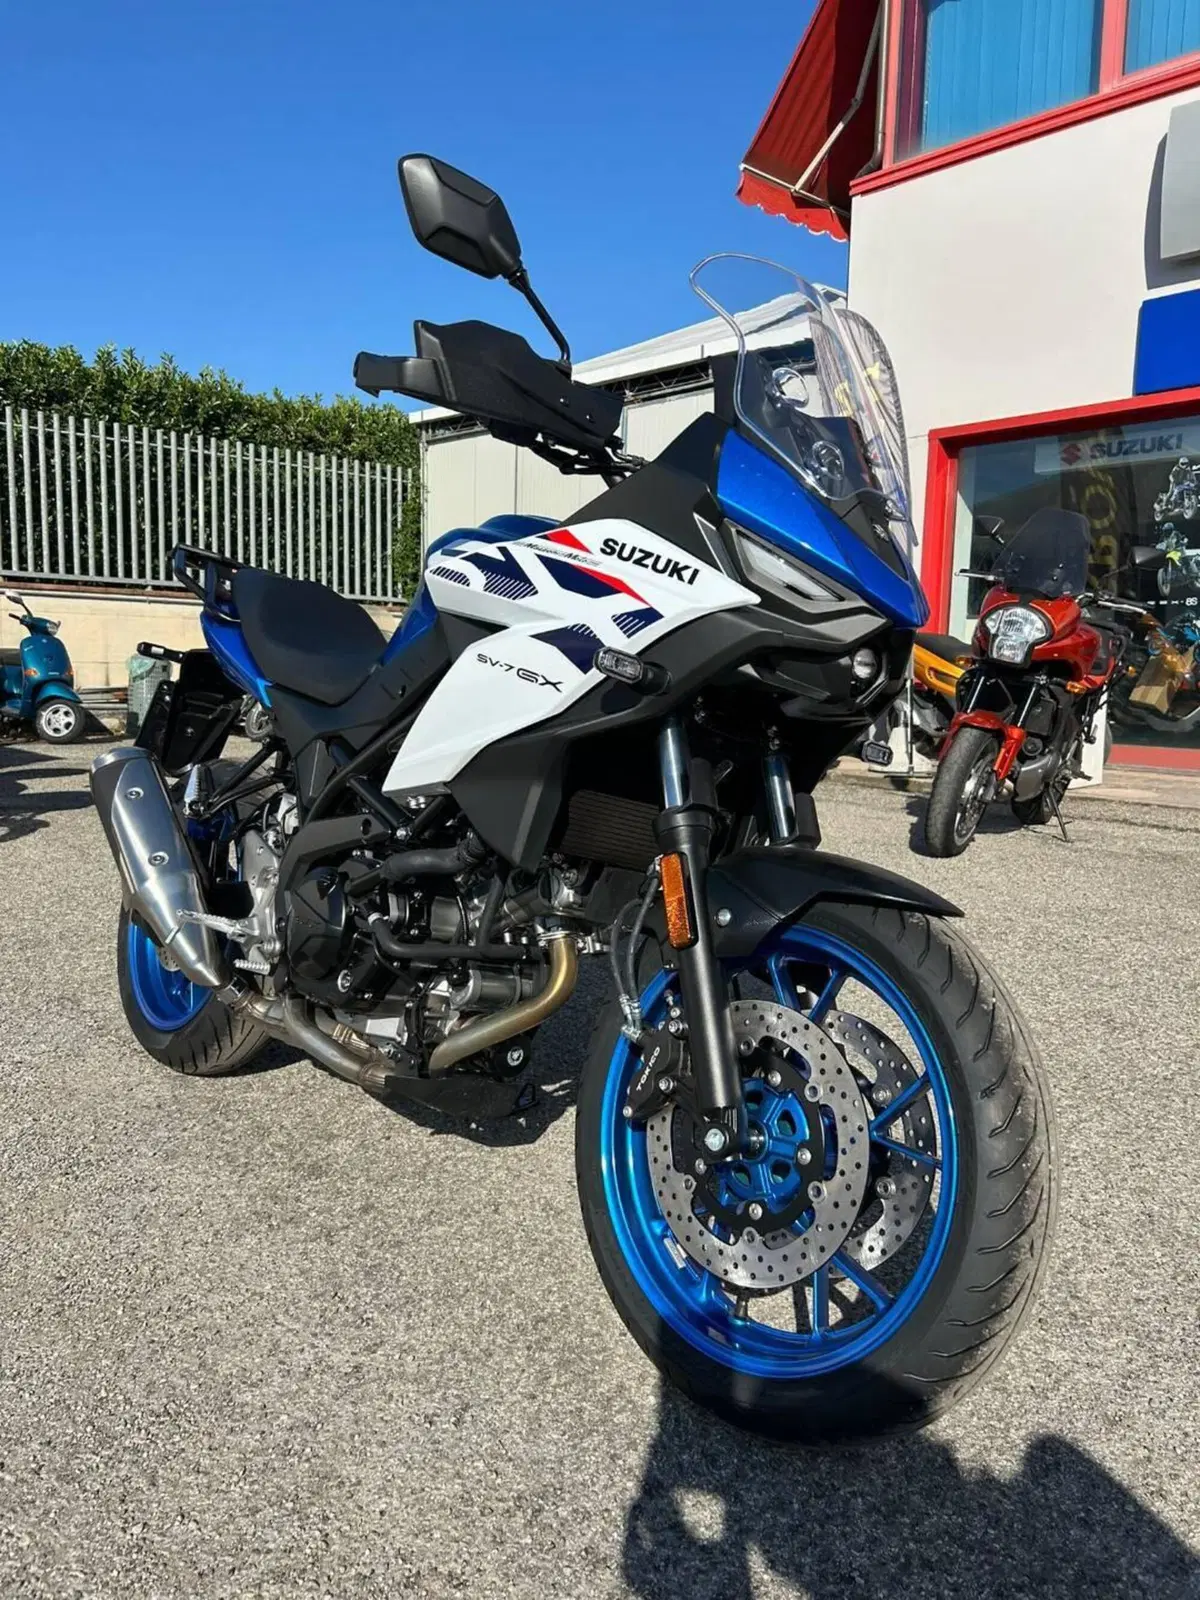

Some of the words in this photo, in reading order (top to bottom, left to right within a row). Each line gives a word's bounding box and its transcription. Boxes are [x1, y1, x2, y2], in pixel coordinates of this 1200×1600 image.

[1090, 433, 1183, 459] SUZUKI
[600, 538, 700, 585] SUZUKI
[636, 1046, 660, 1091] TOKICO
